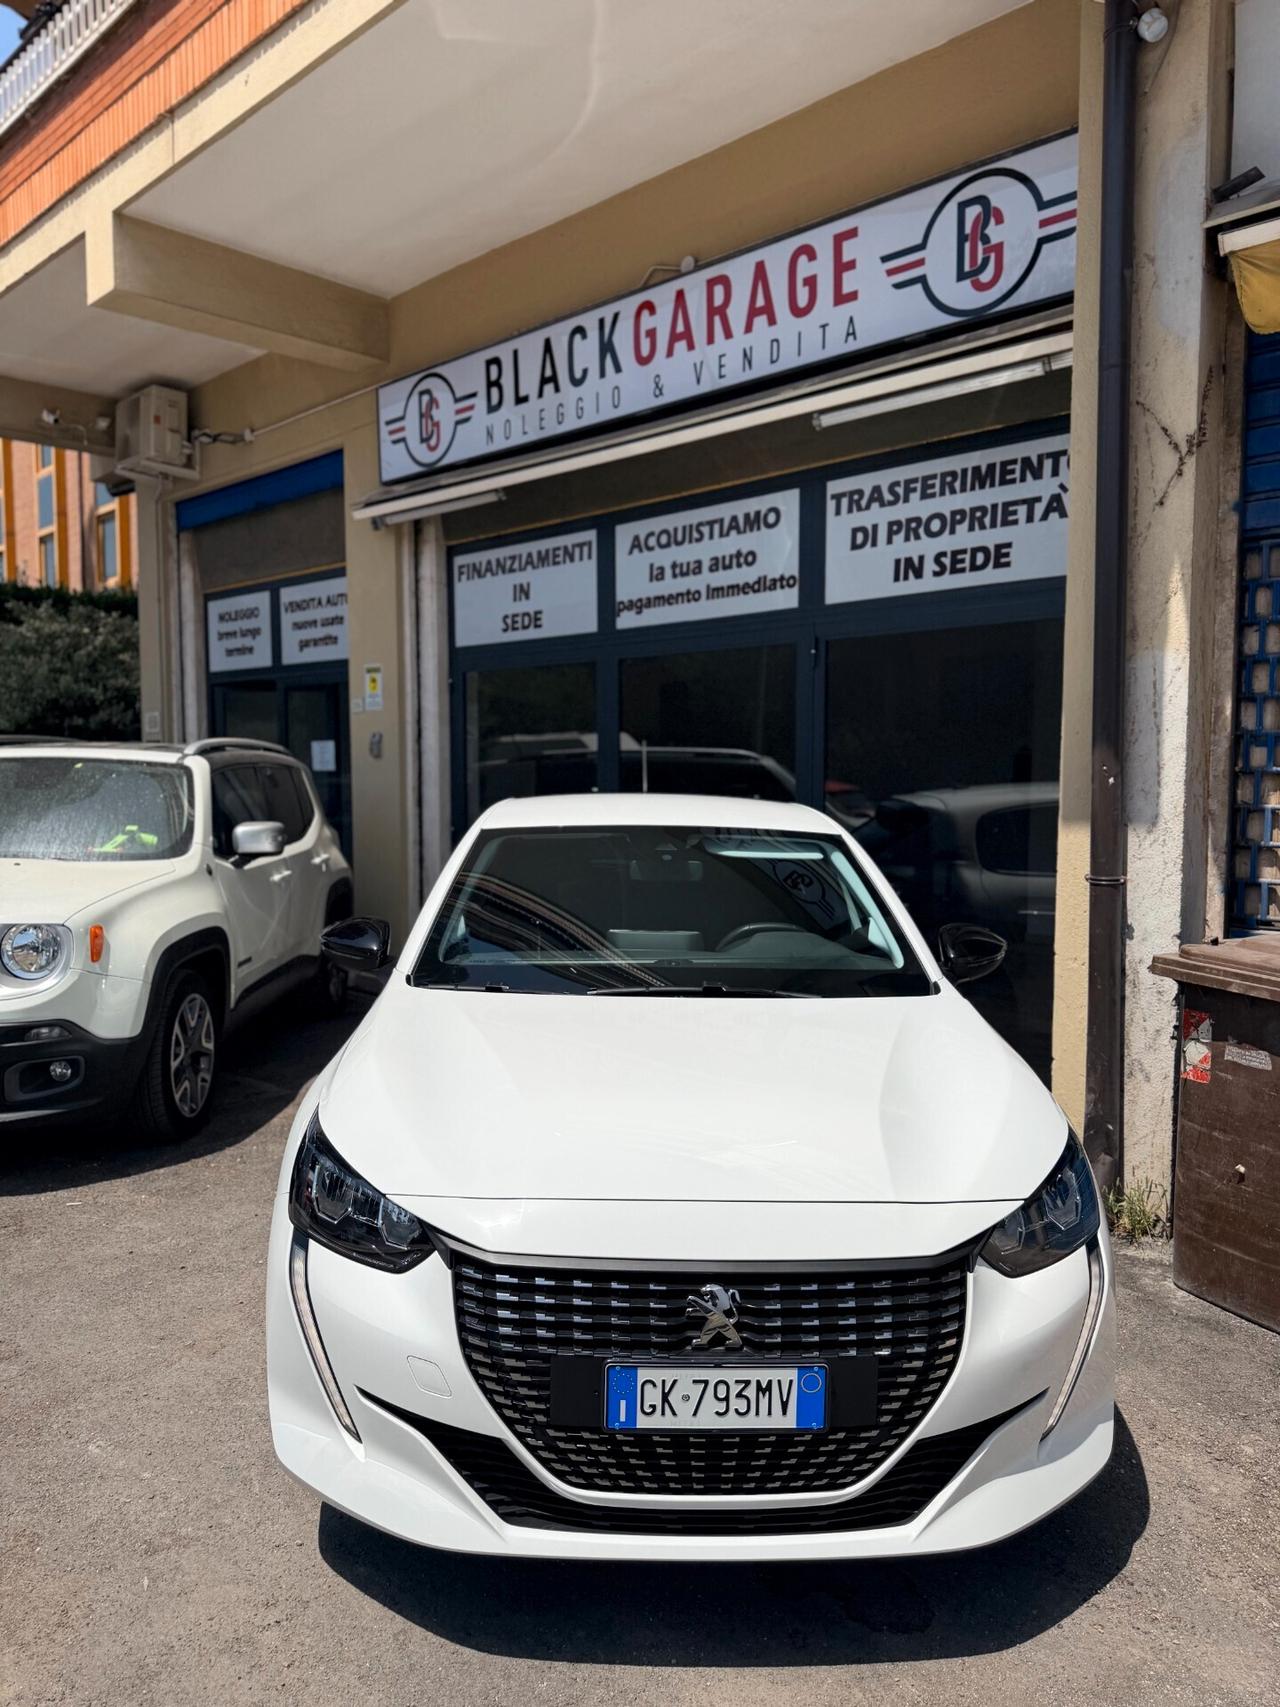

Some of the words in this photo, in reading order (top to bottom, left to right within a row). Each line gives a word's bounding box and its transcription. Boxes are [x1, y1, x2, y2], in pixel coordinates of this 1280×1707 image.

[486, 385, 621, 447] NOLEGGIO
[653, 374, 665, 399] &
[693, 315, 858, 387] VENDITA
[830, 448, 1071, 516] TRASFERIMENT
[628, 506, 782, 556] ACQUISTIAMO
[850, 523, 878, 551] DI
[886, 482, 1069, 545] PROPRIETÀ
[457, 540, 593, 583] FINANZIAMENTI
[649, 562, 666, 583] la
[671, 558, 703, 580] tua
[708, 549, 757, 573] auto
[893, 554, 925, 583] IN
[932, 542, 1013, 578] SEDE
[284, 597, 322, 613] VENDITA
[325, 593, 348, 608] AUT
[513, 582, 531, 603] IN
[616, 588, 702, 618] pagamento
[218, 606, 260, 623] NOLEGGIO
[502, 610, 543, 633] SEDE
